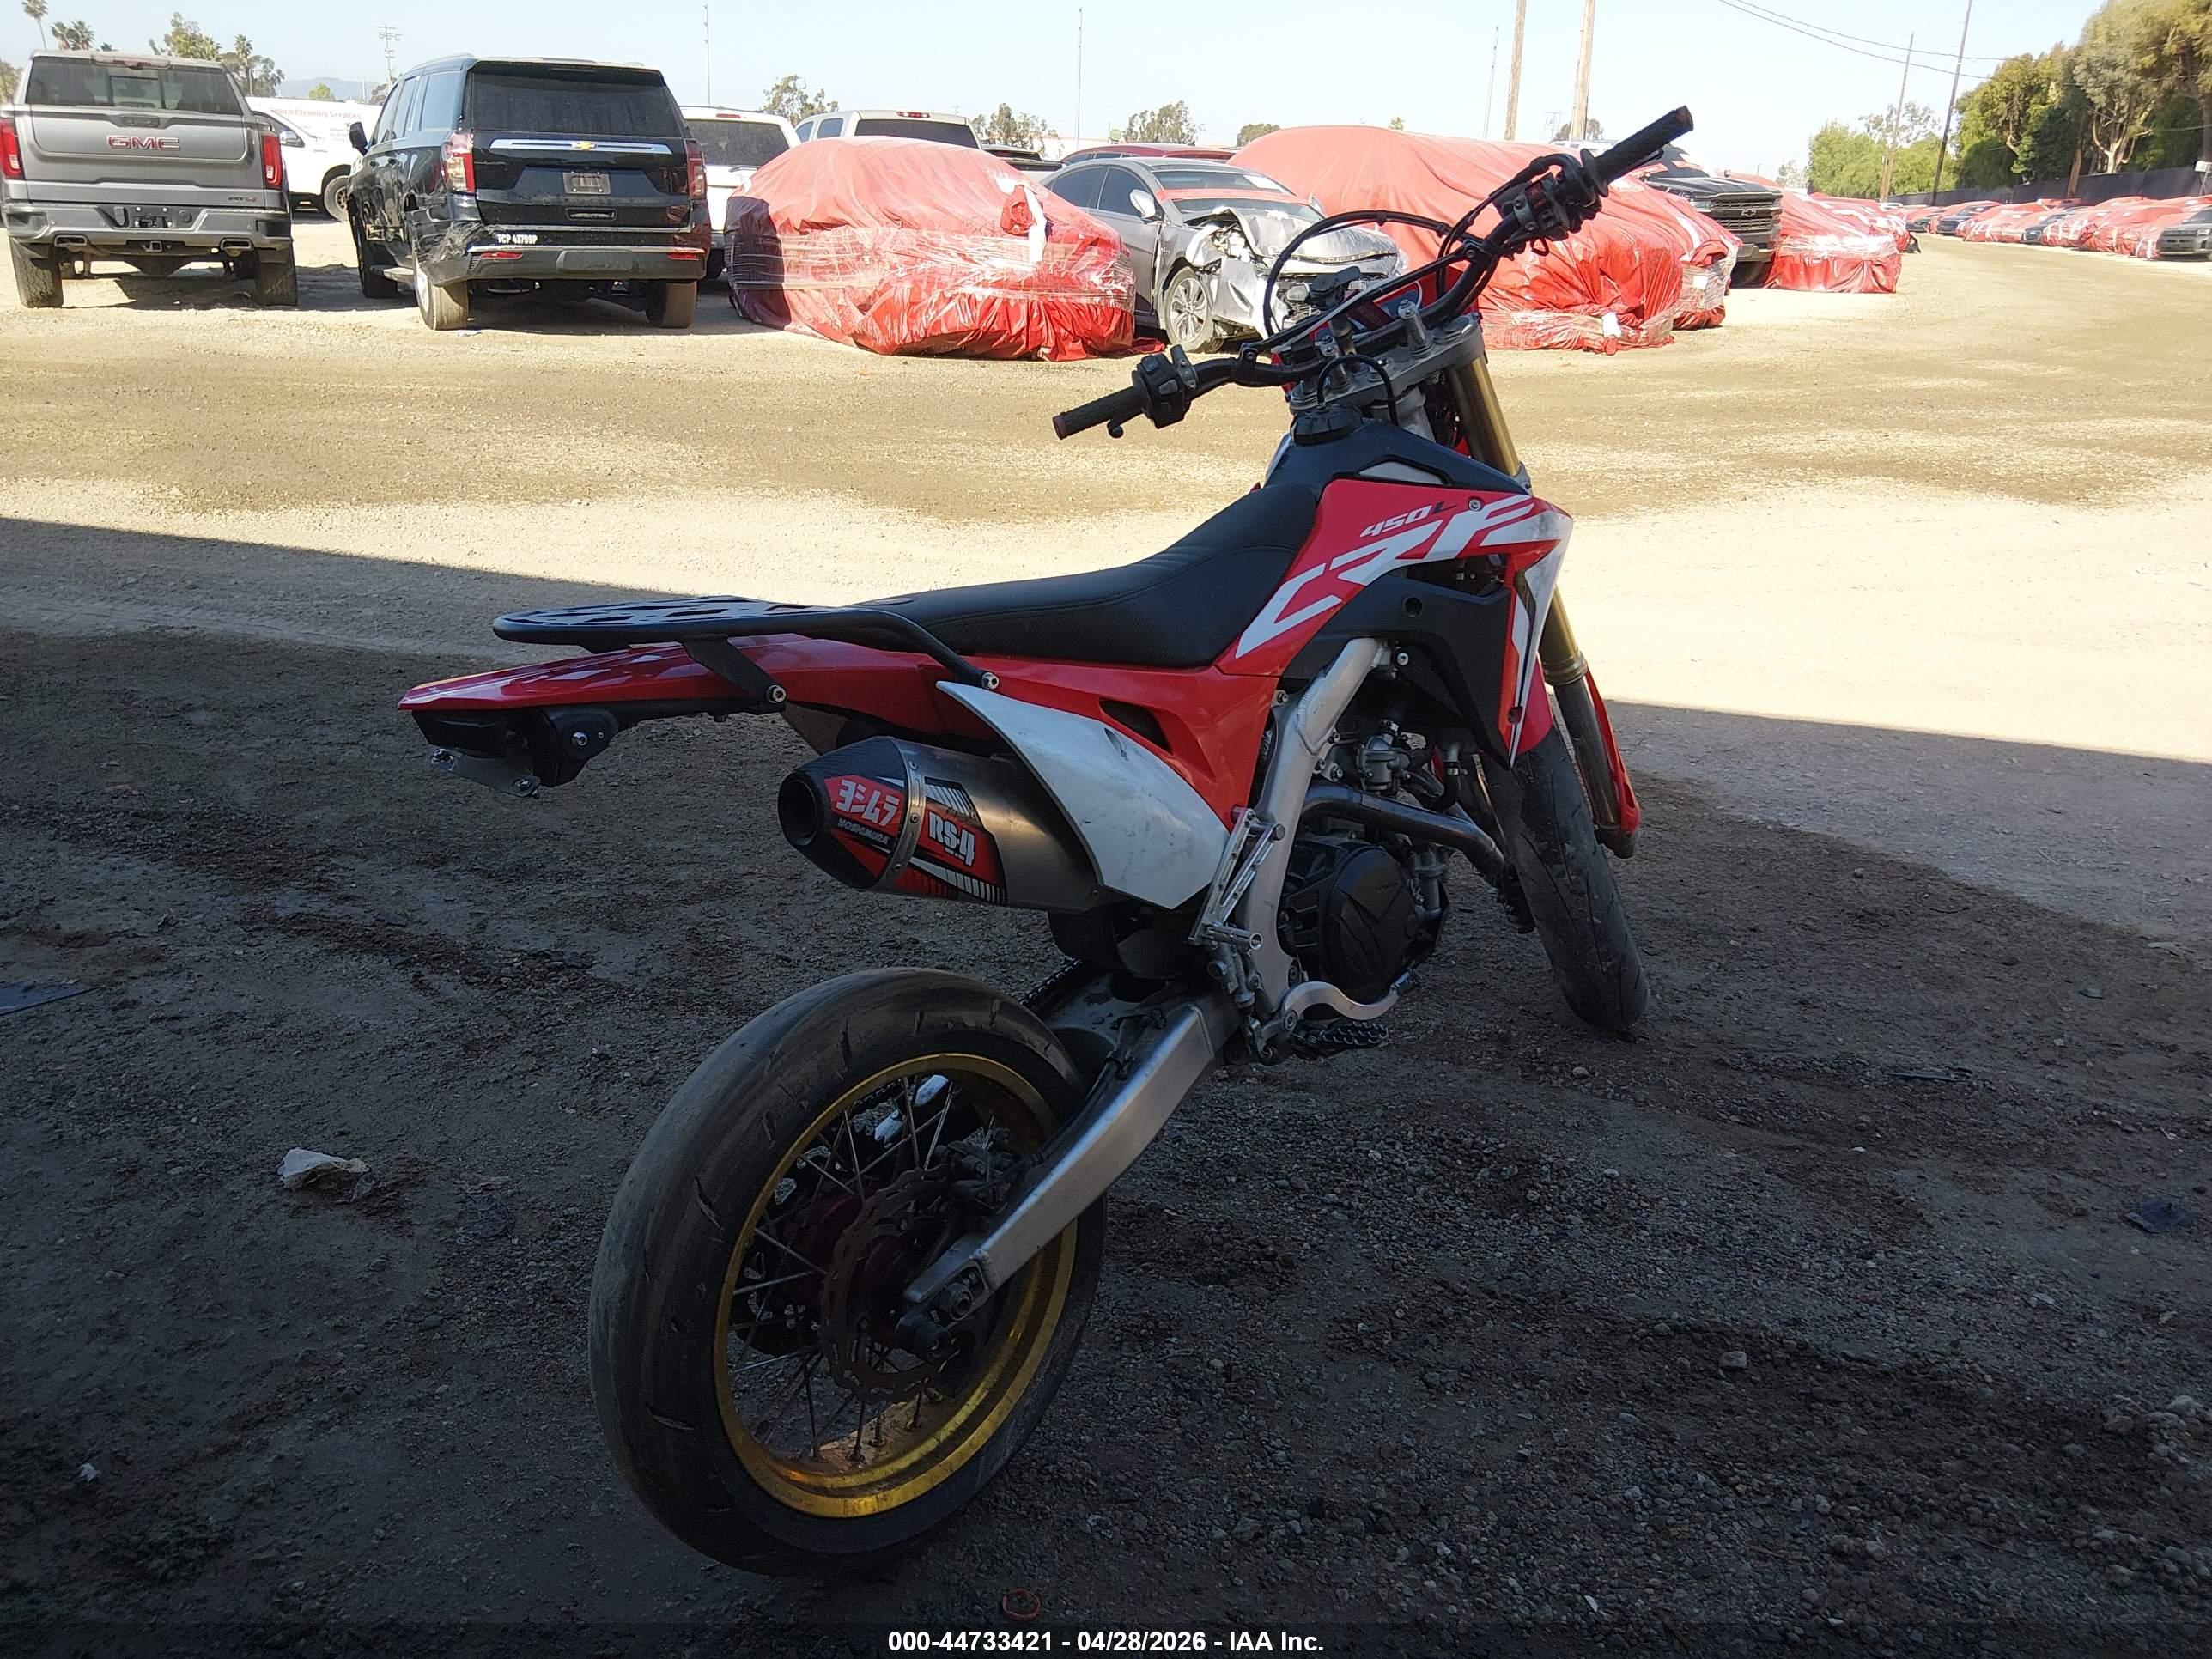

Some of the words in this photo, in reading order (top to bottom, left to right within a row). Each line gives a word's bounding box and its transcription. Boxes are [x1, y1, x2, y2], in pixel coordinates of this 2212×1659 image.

[106, 135, 180, 151] GMC
[496, 234, 511, 243] TCP
[1235, 495, 1559, 659] CRF
[835, 779, 900, 827] ヨシムラ
[837, 817, 890, 845] YOSHIMURA
